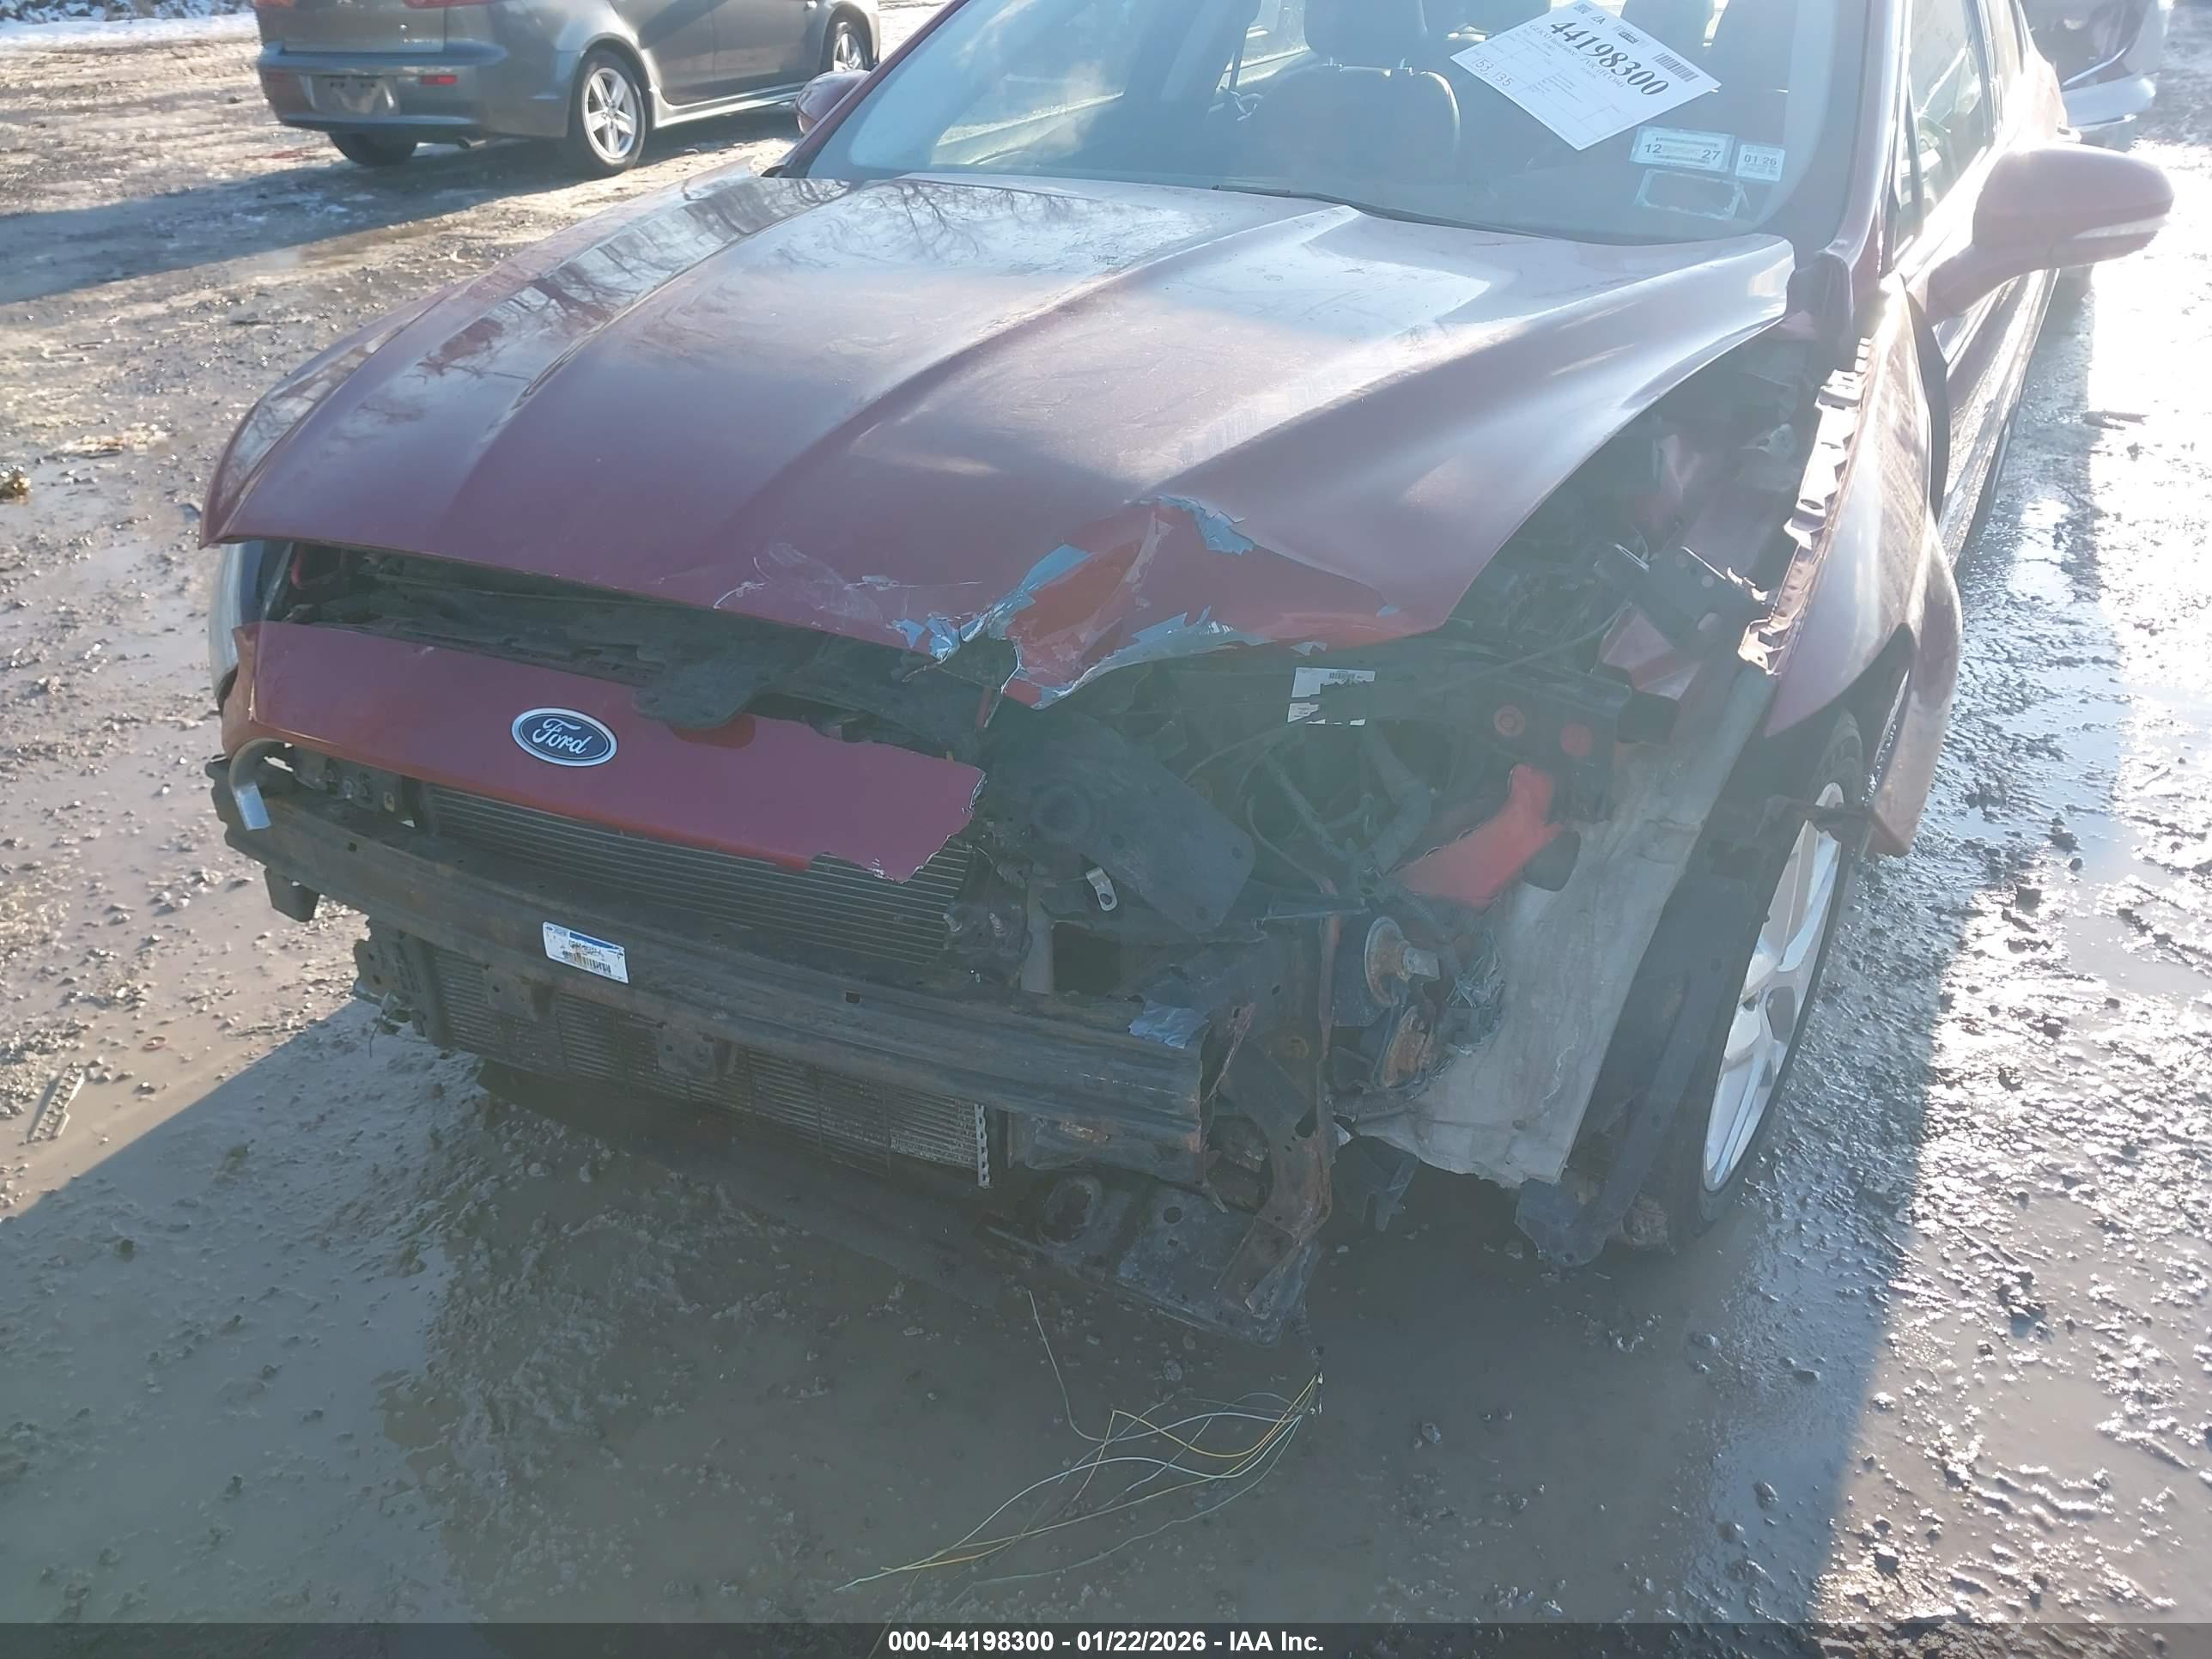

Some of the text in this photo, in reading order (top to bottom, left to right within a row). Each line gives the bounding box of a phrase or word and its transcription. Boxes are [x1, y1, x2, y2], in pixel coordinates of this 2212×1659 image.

[1551, 22, 1668, 95] 44198300
[1644, 143, 1662, 154] 12
[1701, 149, 1722, 161] 27
[532, 718, 592, 754] Ford
